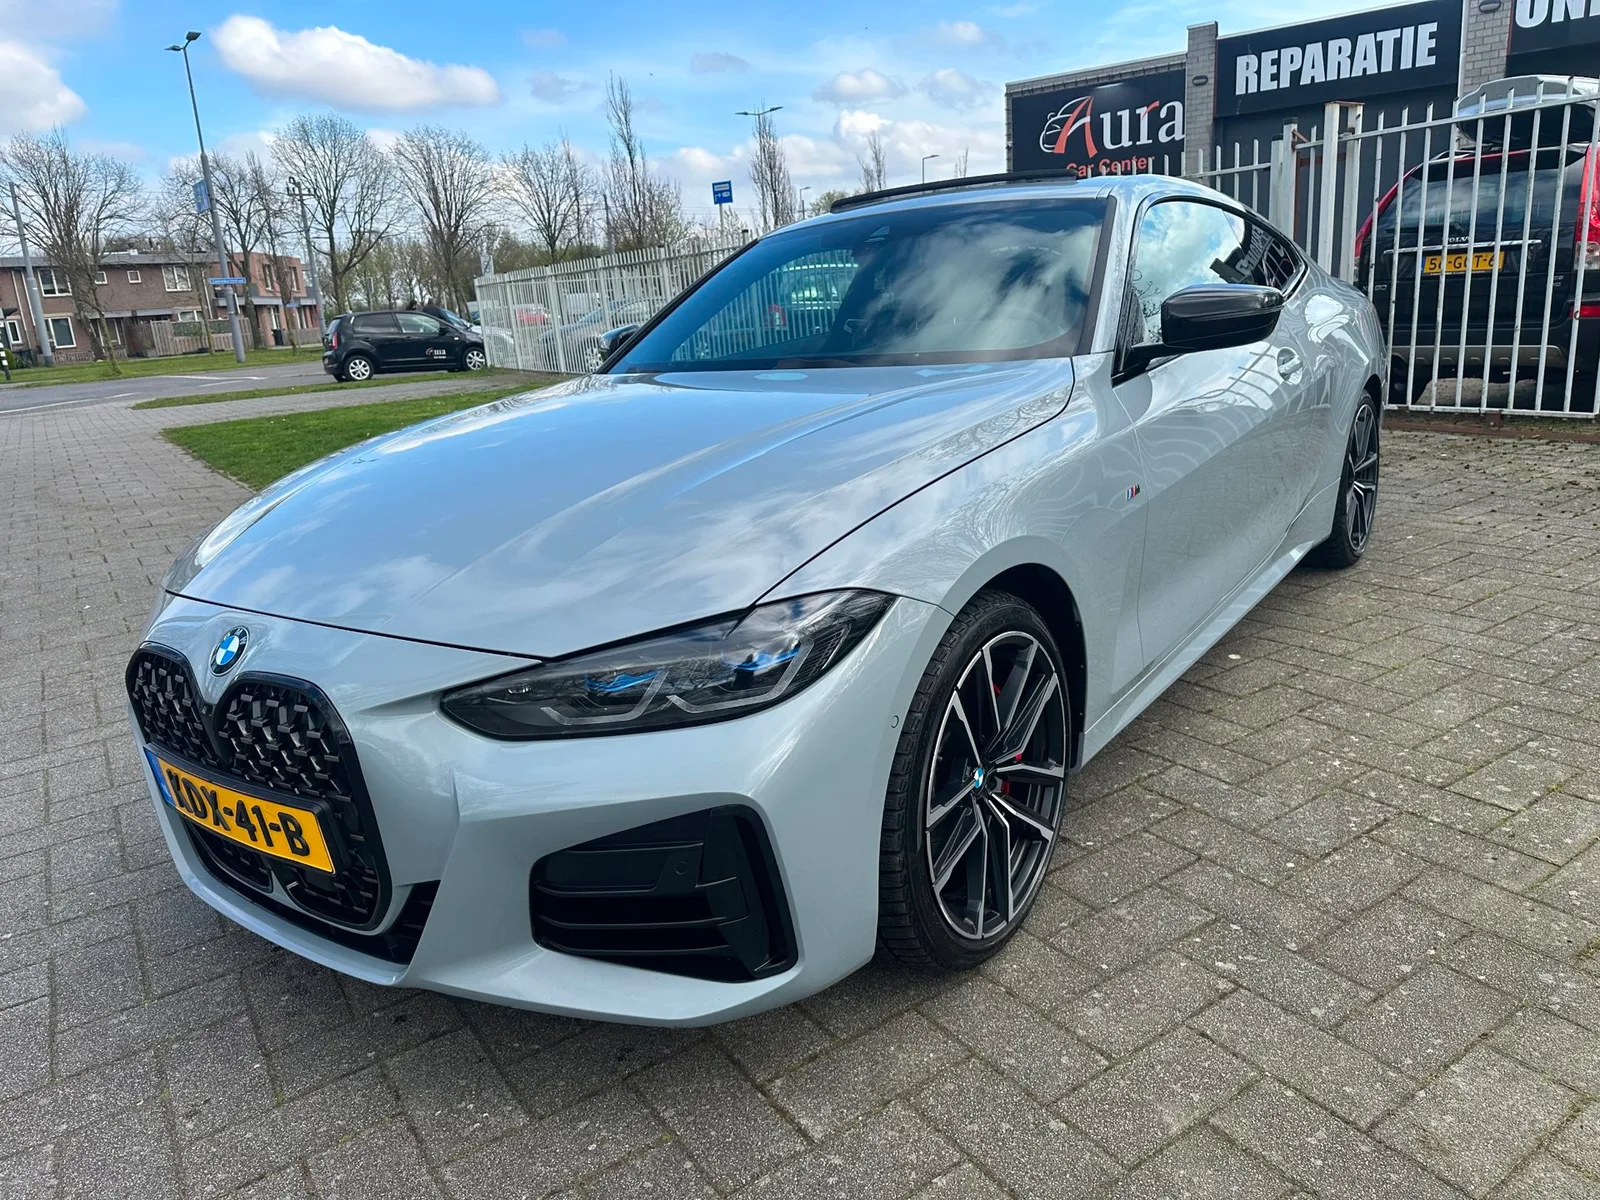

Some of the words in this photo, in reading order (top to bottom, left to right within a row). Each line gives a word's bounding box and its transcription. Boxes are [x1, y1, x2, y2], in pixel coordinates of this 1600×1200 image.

[1235, 22, 1438, 96] REPARATIE
[1053, 96, 1186, 158] Aura
[1428, 254, 1496, 271] 5-GT-6
[166, 768, 311, 857] KDX-41-B
